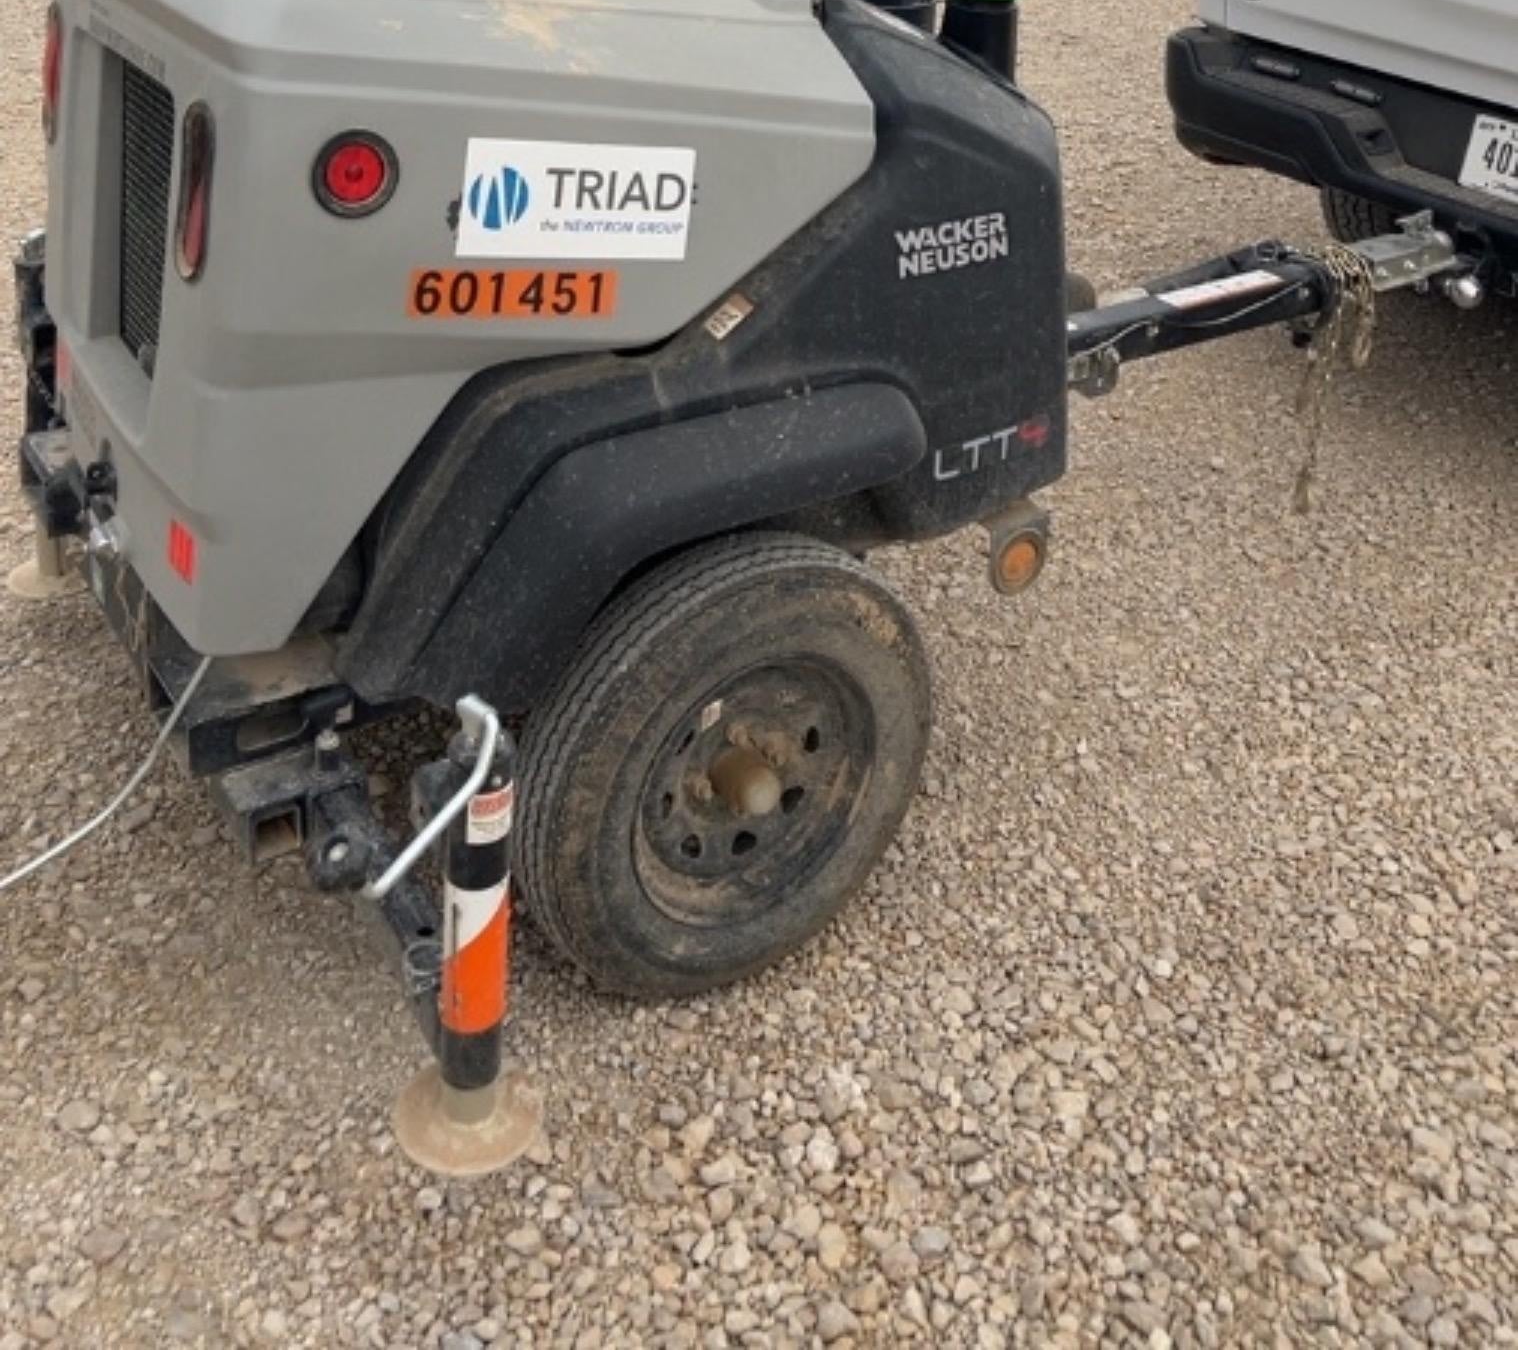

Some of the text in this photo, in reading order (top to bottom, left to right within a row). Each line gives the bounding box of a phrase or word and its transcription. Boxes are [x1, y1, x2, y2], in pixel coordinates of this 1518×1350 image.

[545, 167, 687, 212] TRIAD
[540, 218, 685, 235] the NEWTRON GROUP
[893, 211, 1008, 254] WACKER
[898, 232, 1010, 280] NEUSON
[413, 269, 605, 316] 601451
